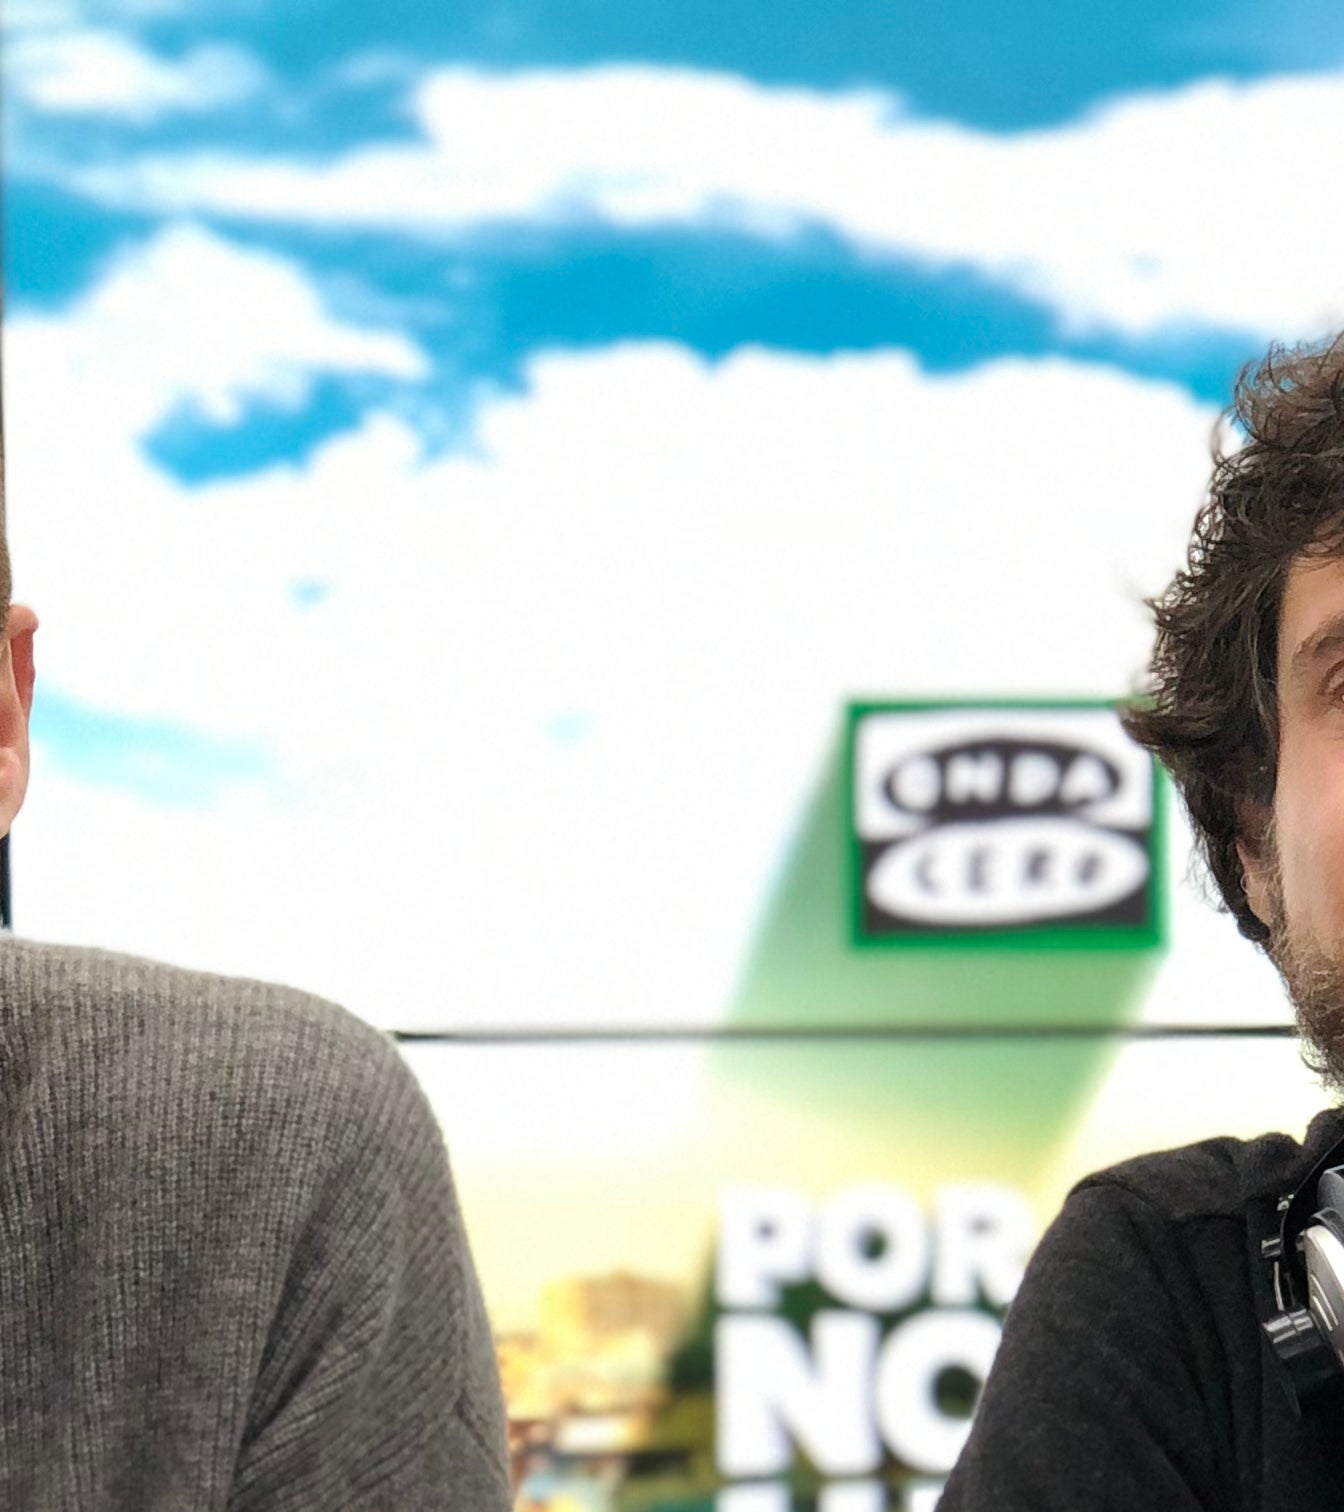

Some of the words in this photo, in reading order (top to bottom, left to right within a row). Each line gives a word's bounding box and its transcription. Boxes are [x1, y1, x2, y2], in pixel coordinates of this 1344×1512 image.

[890, 751, 1115, 811] ONDA
[915, 847, 1103, 893] CERO
[720, 1186, 1031, 1309] POR
[716, 1310, 1003, 1472] NO
